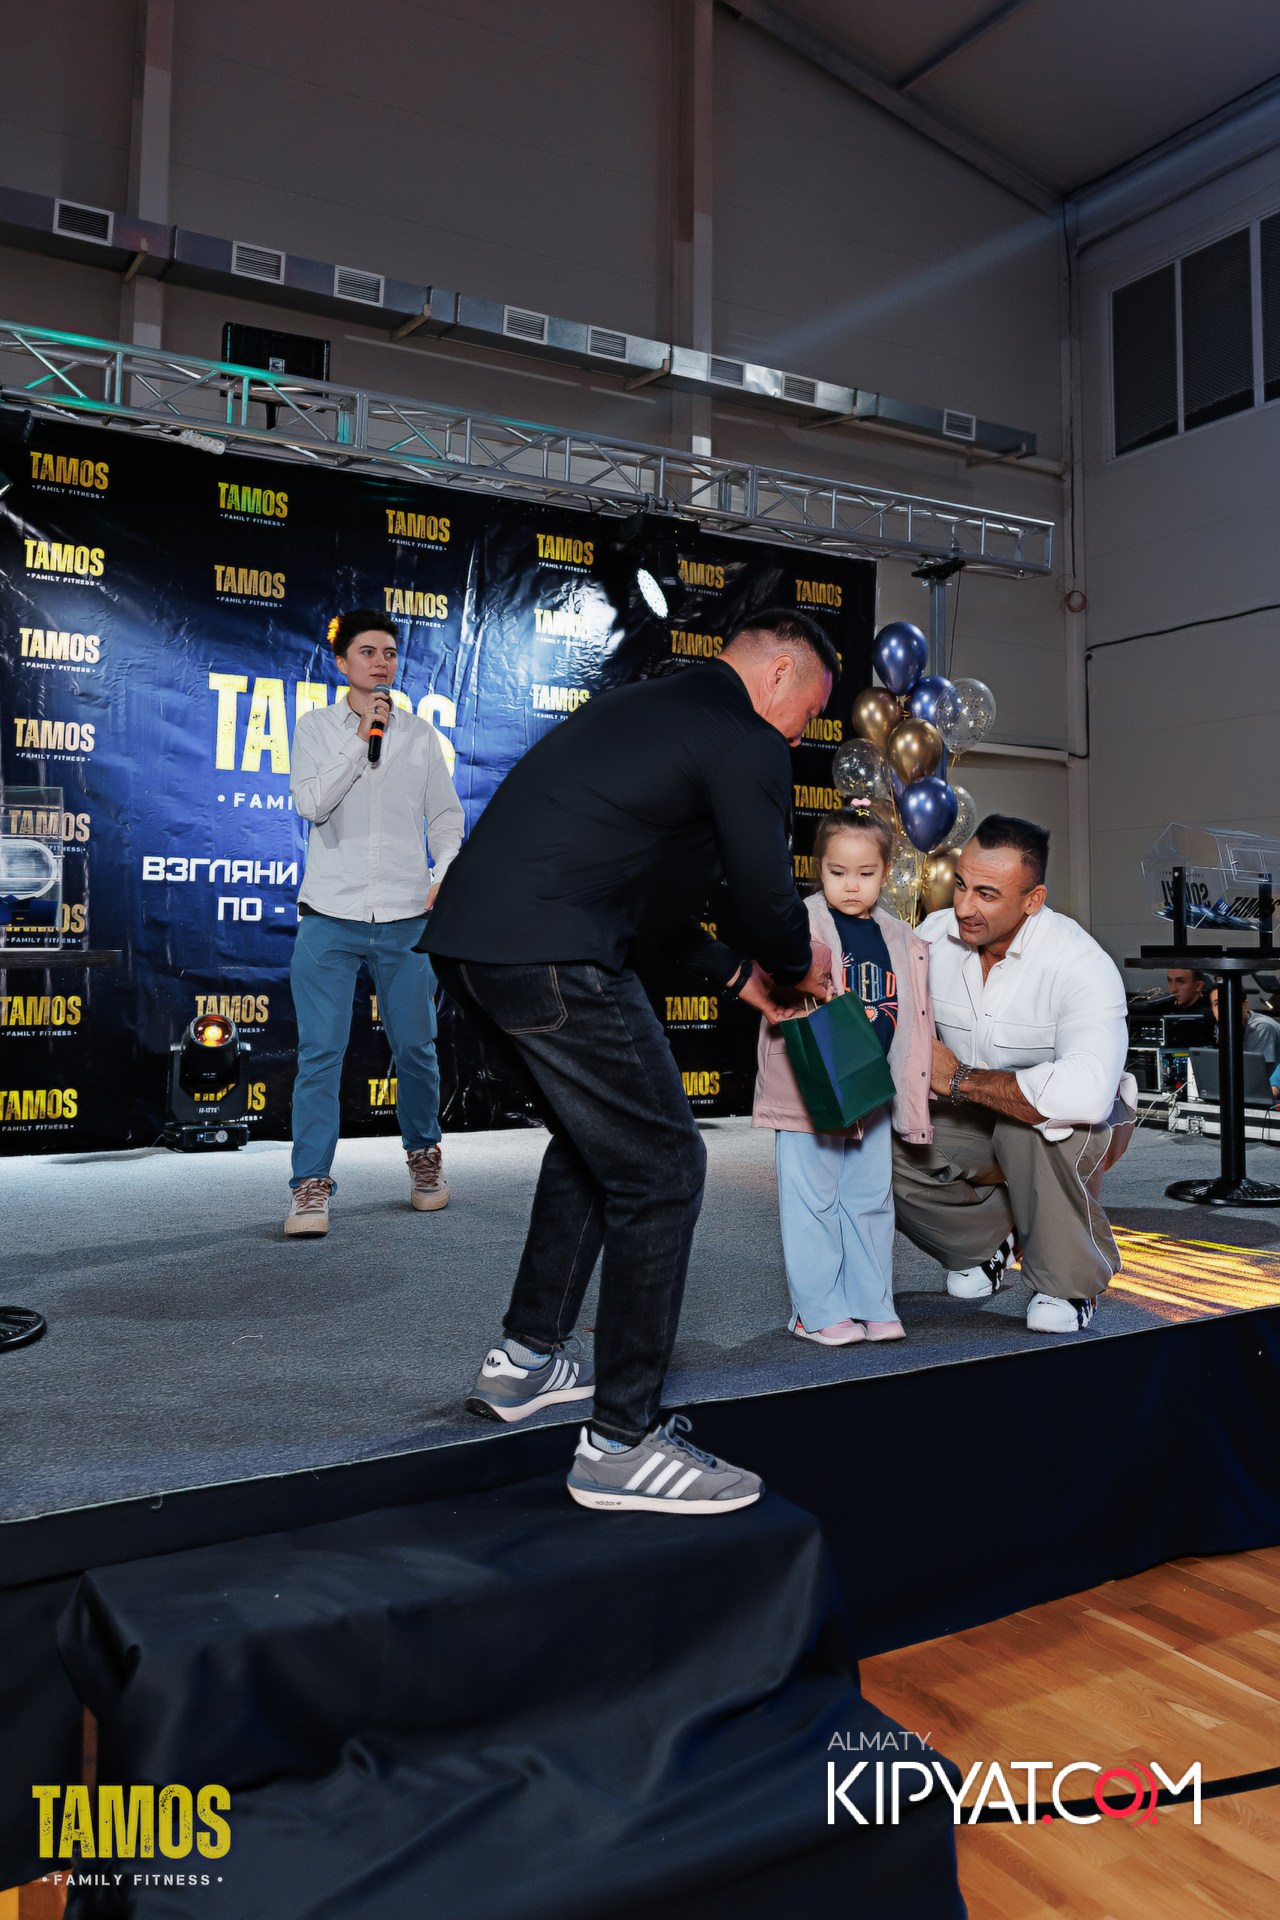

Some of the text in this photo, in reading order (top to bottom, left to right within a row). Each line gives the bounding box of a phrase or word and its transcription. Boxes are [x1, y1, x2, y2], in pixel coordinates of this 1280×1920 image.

[30, 451, 109, 490] TAMOS
[36, 484, 100, 499] FAMILY FITNESS
[218, 482, 289, 518] TAMOS
[224, 513, 281, 526] FAMILY FITNESS
[386, 508, 450, 543] TAMOS
[24, 539, 105, 576] TAMOS
[392, 538, 443, 551] FAMILY FITNESS
[536, 533, 594, 565] TAMOS
[31, 573, 95, 586] FAMILY FITNESS
[541, 562, 588, 573] FAMILY FITNESS
[678, 560, 725, 589] AMOS
[214, 565, 286, 599] TAMOS
[795, 579, 842, 607] TAMOS
[220, 596, 278, 608] FAMILY FITNESS
[384, 587, 448, 620] TAMOS
[415, 620, 441, 628] FITNESS
[19, 628, 100, 664] TAMOS
[671, 630, 723, 657] TAMOS
[26, 661, 91, 673] FAMILY FITNESS
[14, 718, 95, 752] TAMOS
[208, 672, 457, 777] TAS
[801, 718, 842, 742] AMOS
[20, 752, 51, 760] FAMILY
[233, 792, 293, 811] FAMI
[794, 785, 842, 810] TAMOS
[9, 810, 91, 842] TAMOS
[142, 856, 298, 886] ВЗГЛЯНИ
[217, 896, 263, 922] ПО
[0, 995, 82, 1026] TAMOS
[195, 994, 269, 1023] TAMOS
[665, 996, 719, 1021] TAMOS
[682, 1071, 720, 1096] MOS
